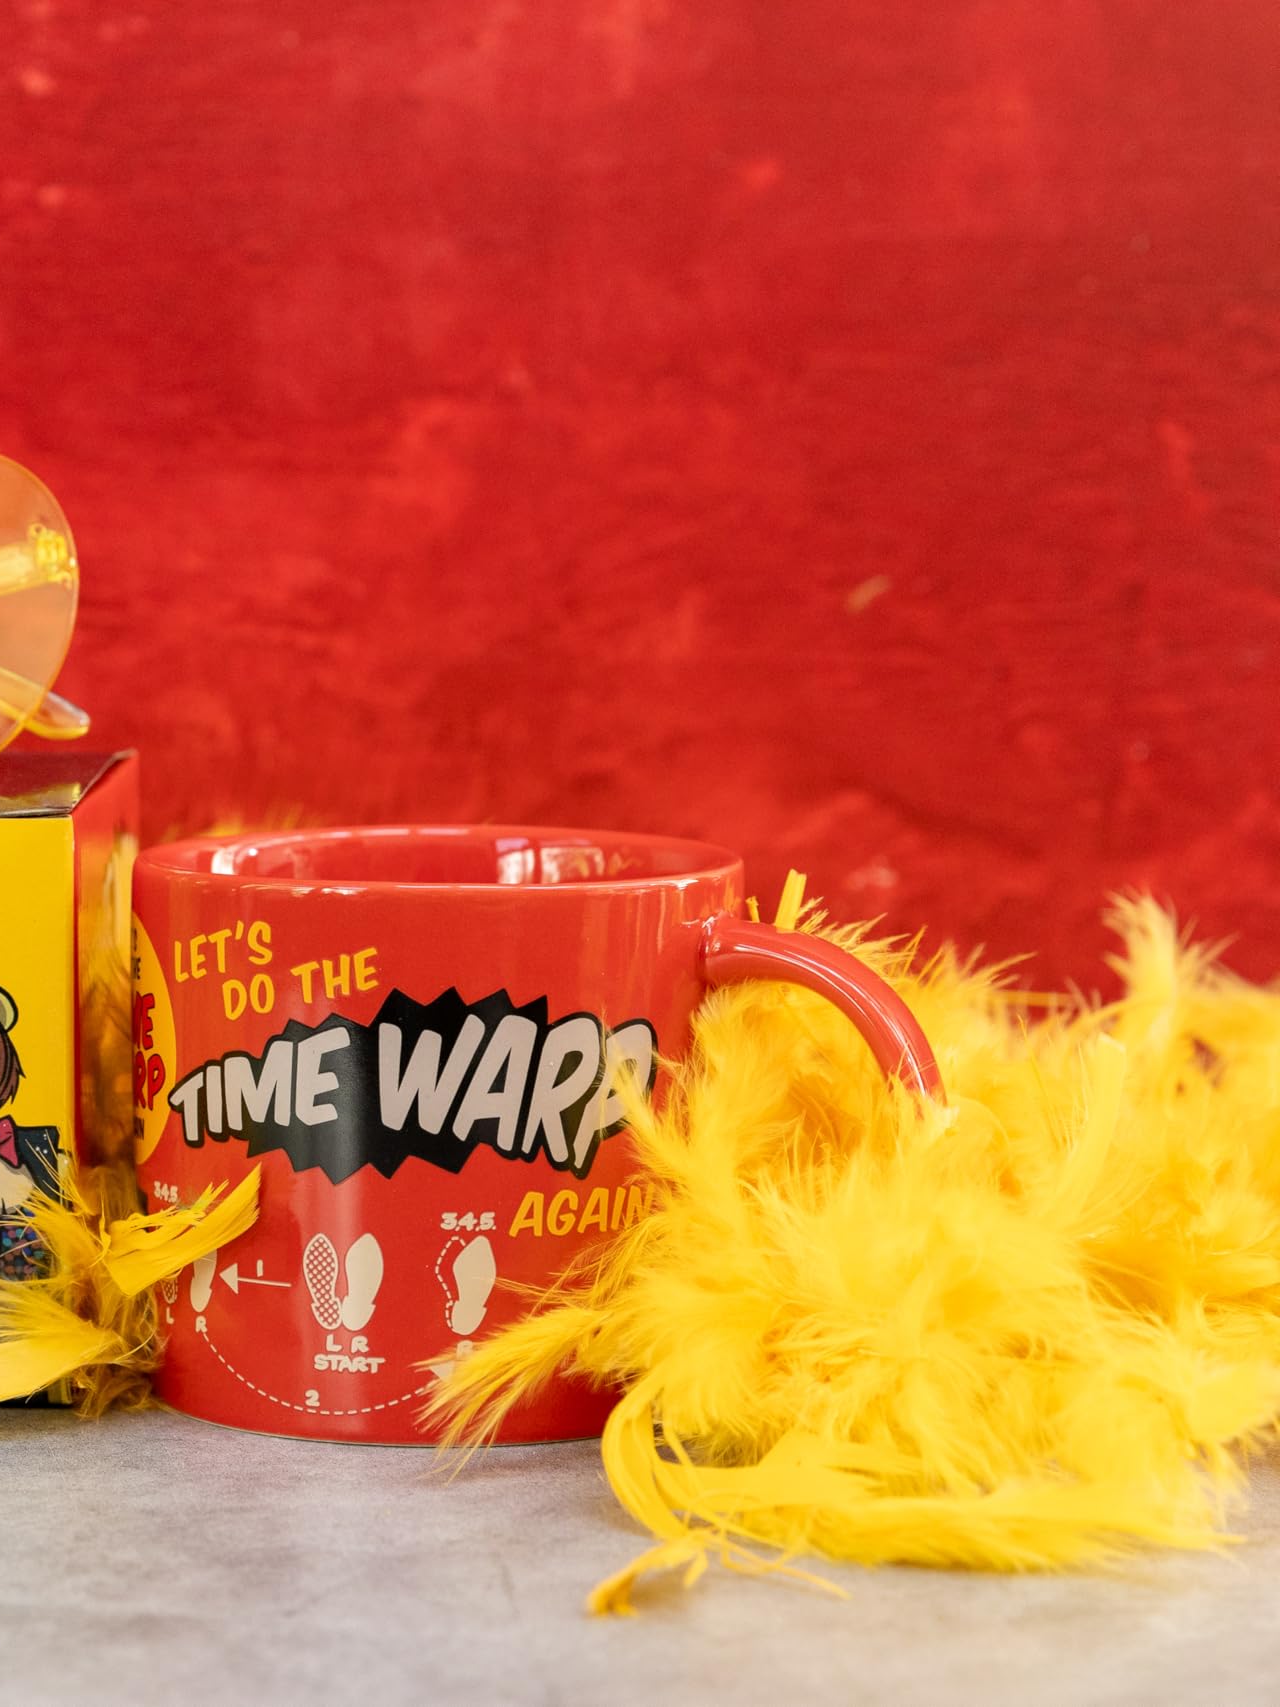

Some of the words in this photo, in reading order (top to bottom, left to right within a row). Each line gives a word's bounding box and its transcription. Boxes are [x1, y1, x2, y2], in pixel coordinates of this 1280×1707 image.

[174, 920, 273, 983] LET'S
[222, 974, 275, 1020] DO
[291, 947, 379, 1003] THE
[171, 1025, 353, 1142] TIME
[378, 1014, 654, 1169] WARP
[508, 1184, 656, 1238] AGAIN
[195, 1315, 208, 1333] R
[326, 1334, 342, 1352] L
[351, 1335, 369, 1353] R
[314, 1353, 386, 1374] START
[304, 1389, 320, 1407] 2
